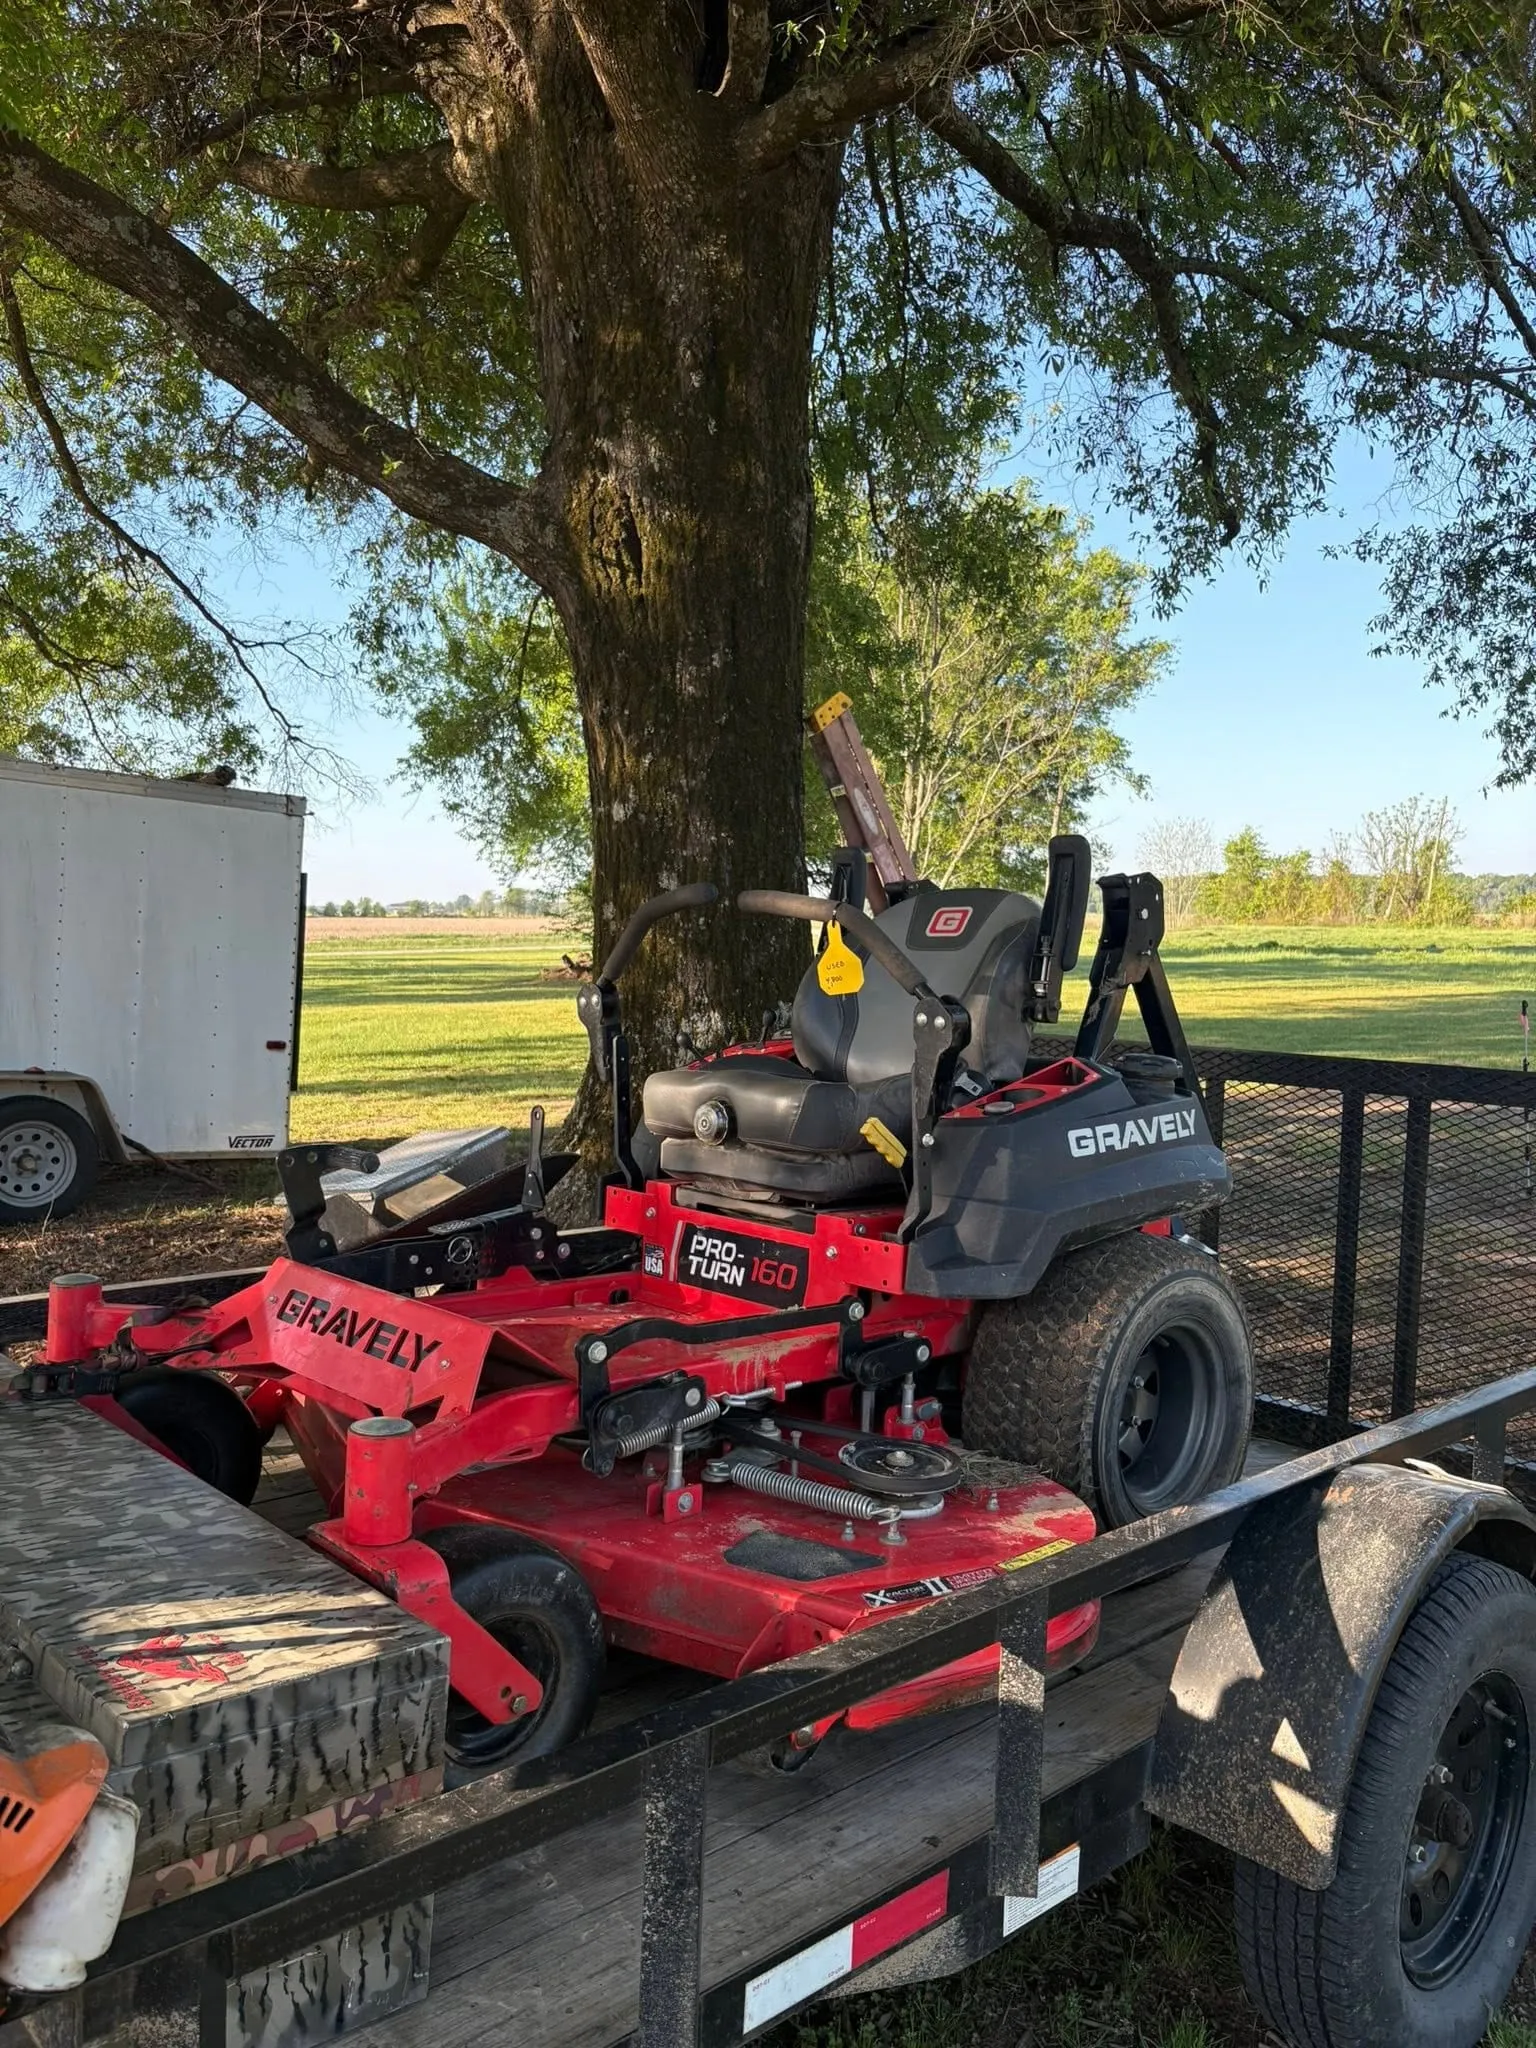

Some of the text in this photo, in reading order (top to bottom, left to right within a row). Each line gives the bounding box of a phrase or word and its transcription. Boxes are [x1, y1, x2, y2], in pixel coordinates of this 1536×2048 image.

[825, 960, 846, 971] USED
[228, 1135, 276, 1148] VECTOR
[1067, 1109, 1196, 1158] GRAVELY
[690, 1235, 744, 1263] PRO-
[644, 1256, 664, 1275] USA
[688, 1255, 798, 1290] TURN 160
[276, 1288, 443, 1373] GRAVELY
